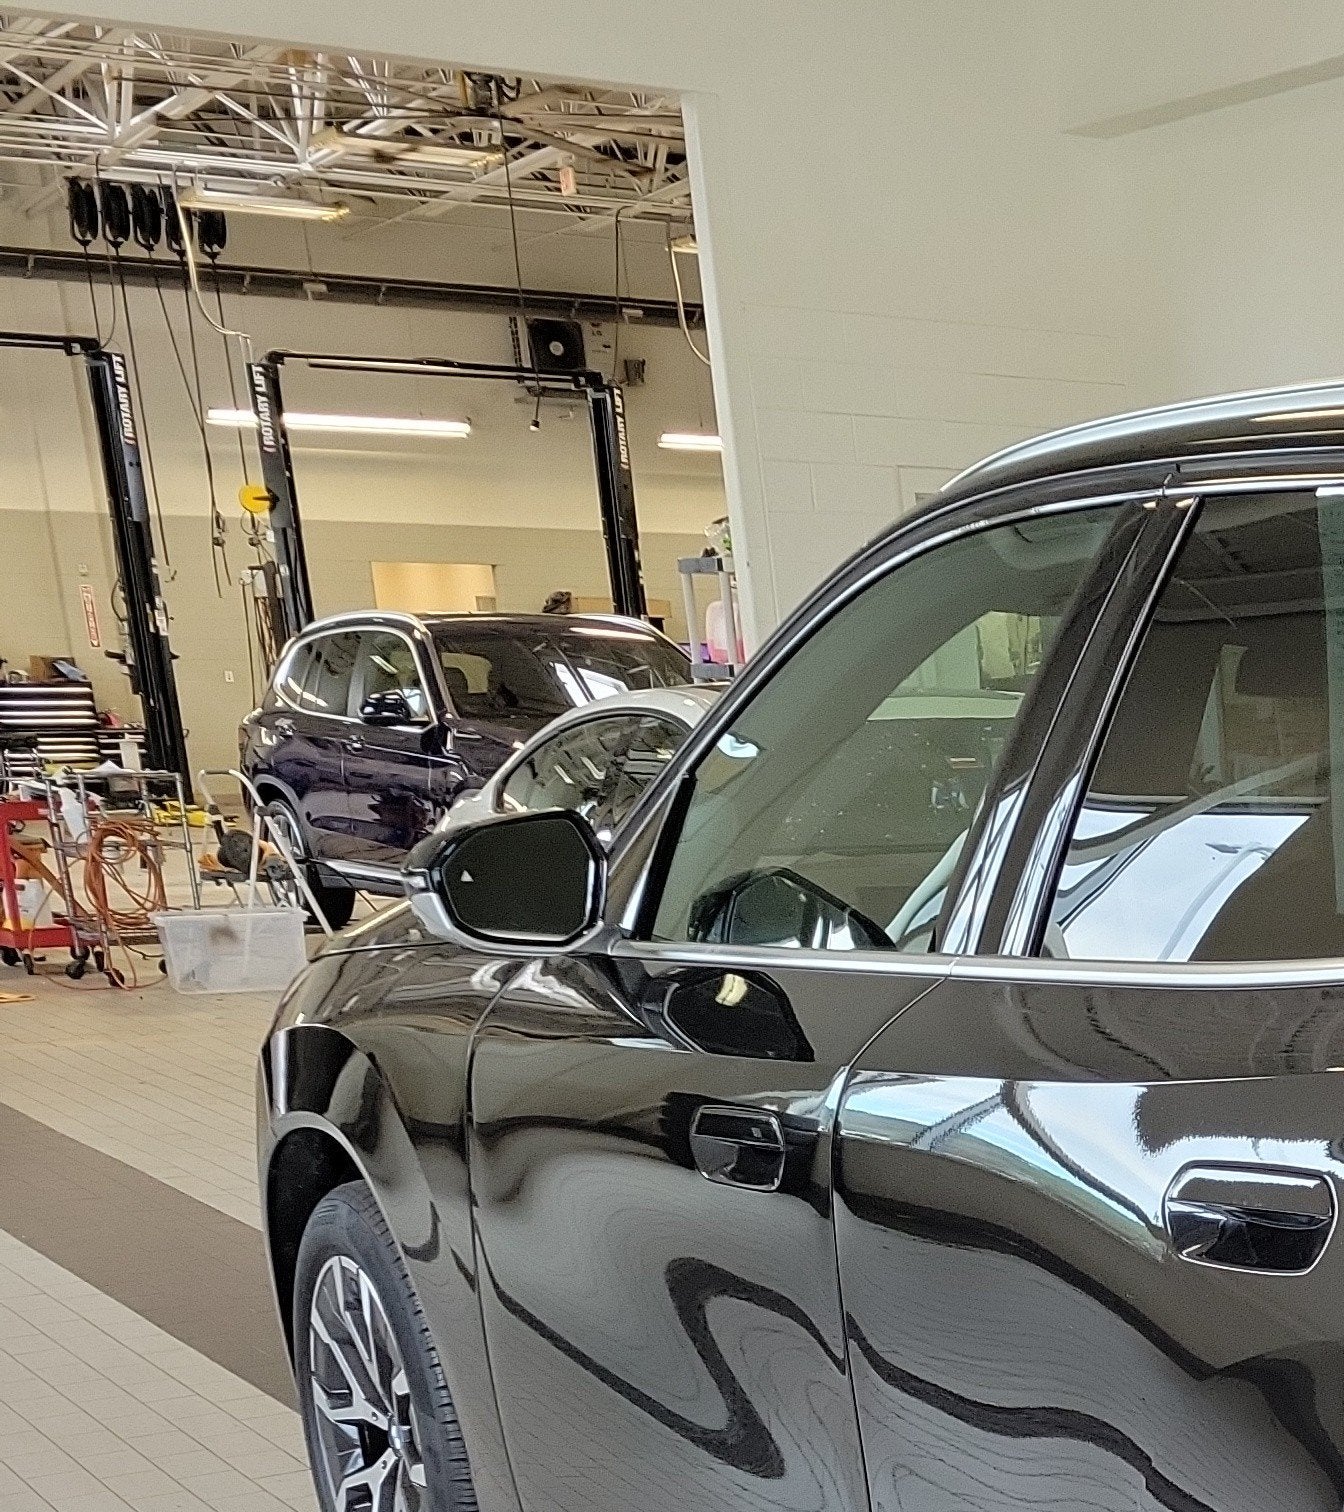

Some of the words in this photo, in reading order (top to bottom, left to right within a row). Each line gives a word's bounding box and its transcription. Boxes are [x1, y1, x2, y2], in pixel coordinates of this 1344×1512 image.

[111, 352, 128, 384] LIFT
[251, 363, 267, 392] LIFT
[116, 384, 137, 440] ROTARY
[256, 393, 276, 446] ROTARY
[616, 414, 630, 463] ROTARY
